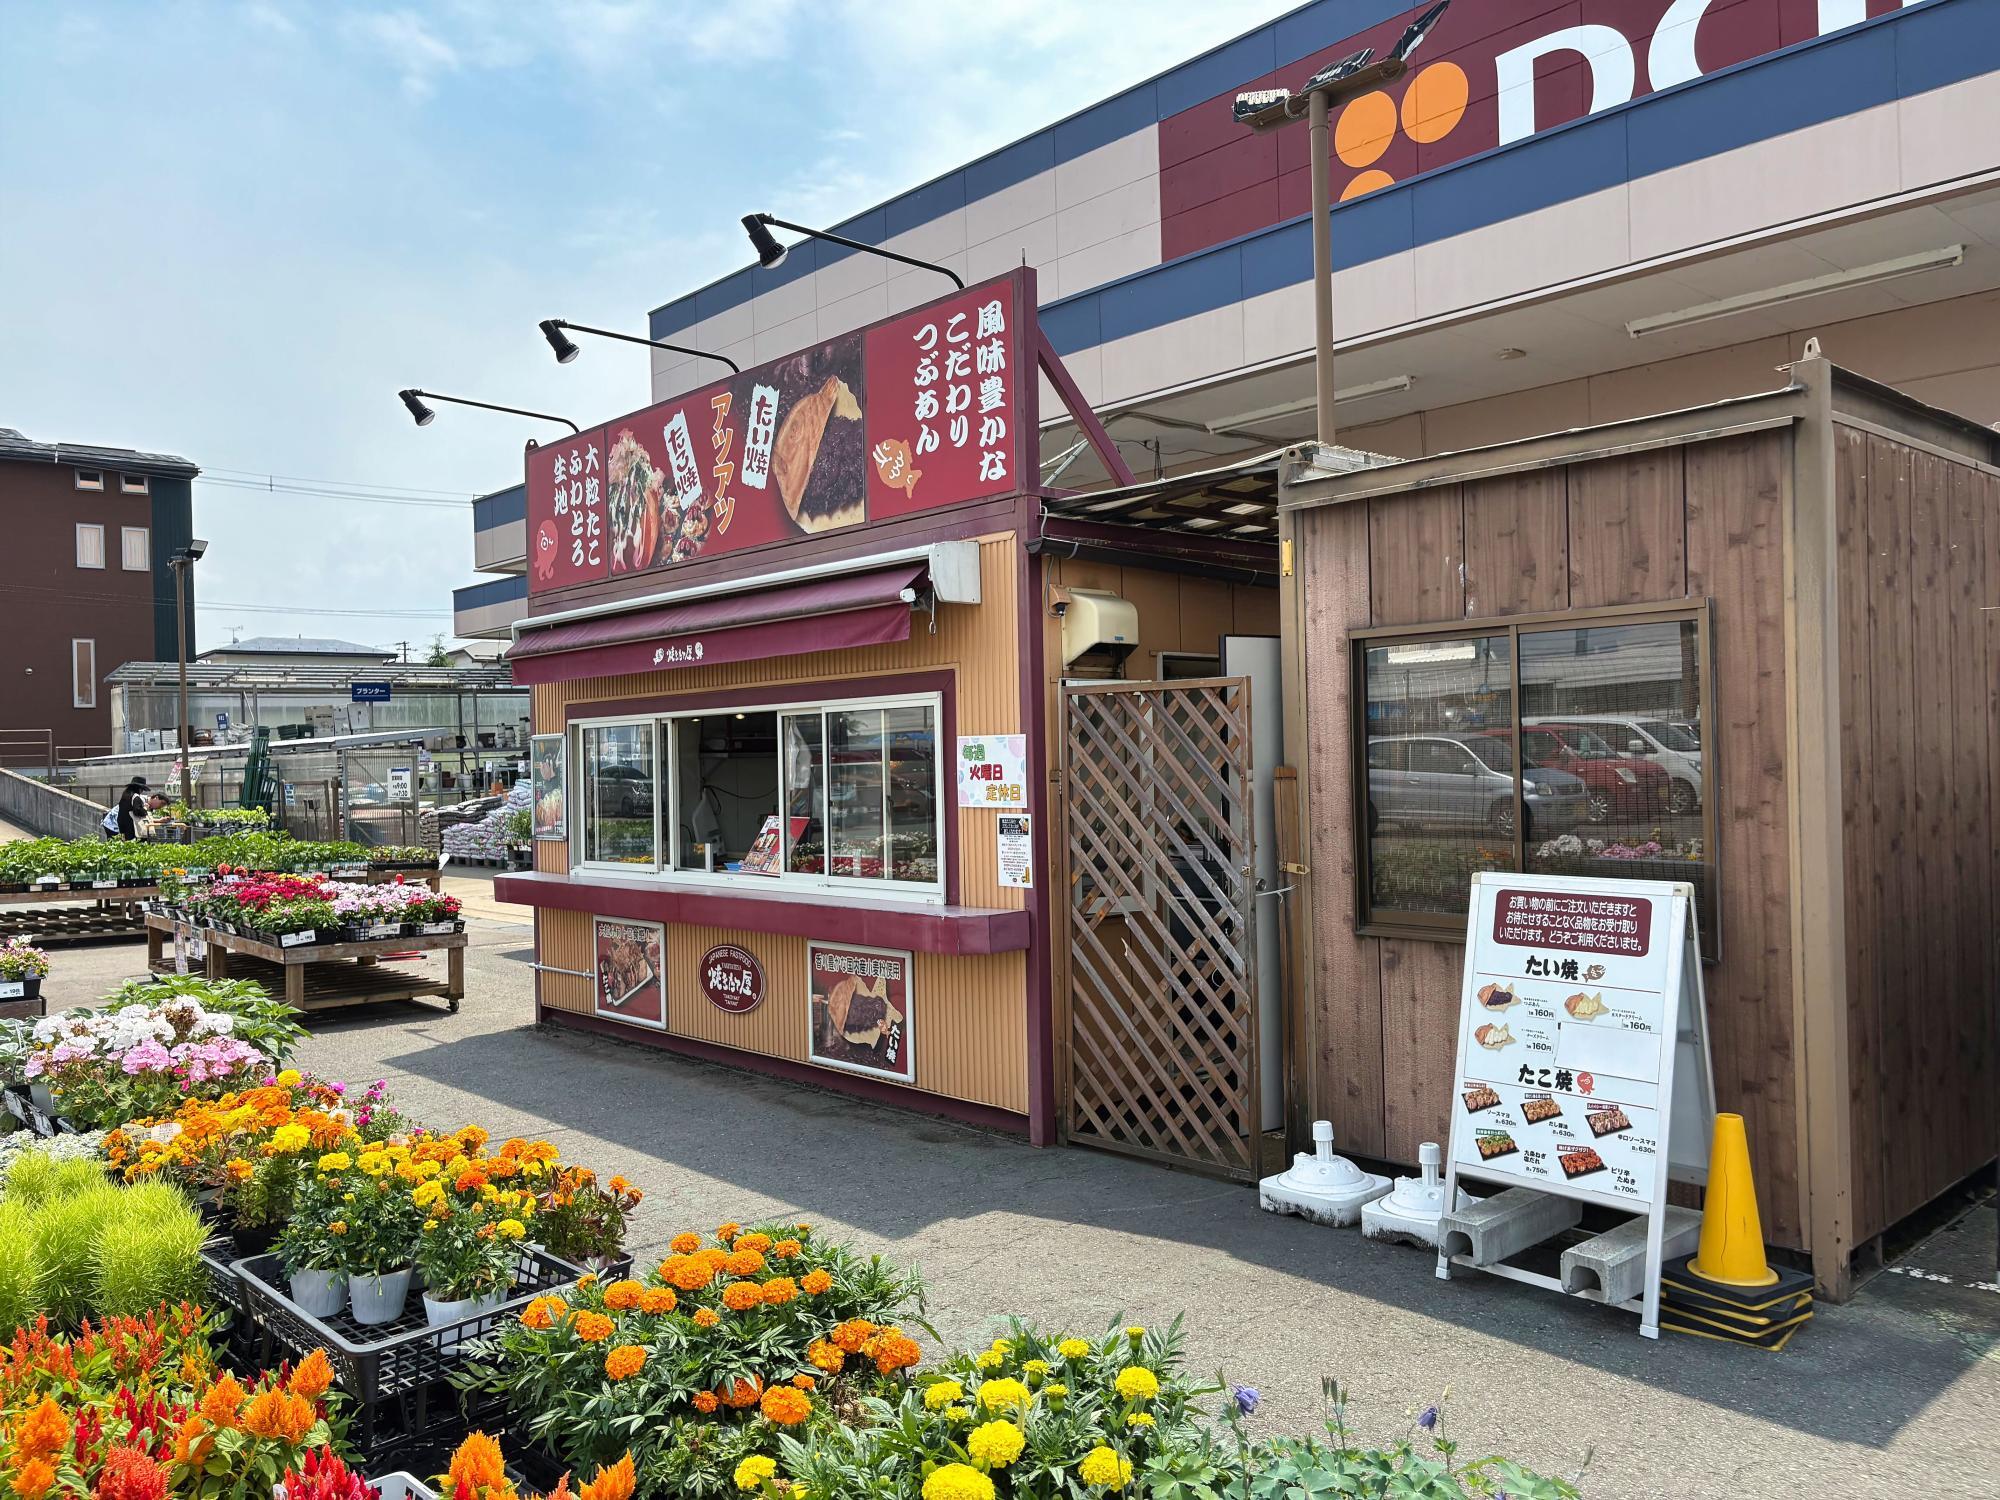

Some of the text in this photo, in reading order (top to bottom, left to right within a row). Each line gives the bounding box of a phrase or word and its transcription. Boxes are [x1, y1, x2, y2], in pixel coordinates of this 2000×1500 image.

[912, 323, 940, 456] つぶあん
[944, 312, 971, 448] こだわり
[976, 299, 1007, 482] 風味豊かな
[744, 394, 774, 477] たい焼
[553, 454, 569, 516] 生地
[668, 425, 700, 499] たこ焼
[710, 390, 736, 536] アツアツ
[568, 449, 585, 567] ふわとろ
[584, 443, 601, 566] 大粒たこ
[356, 687, 386, 695] プランター
[962, 743, 986, 761] 毎週
[969, 764, 1004, 781] 火曜日
[985, 784, 1022, 801] 定休日
[1505, 911, 1638, 934] お待たせすることなく品物をお受け取り
[1509, 896, 1637, 917] お買い物の前にご注文いただきますと
[1525, 955, 1579, 981] たい焼
[886, 1024, 900, 1063] たい焼
[1518, 1064, 1573, 1092] たこ焼
